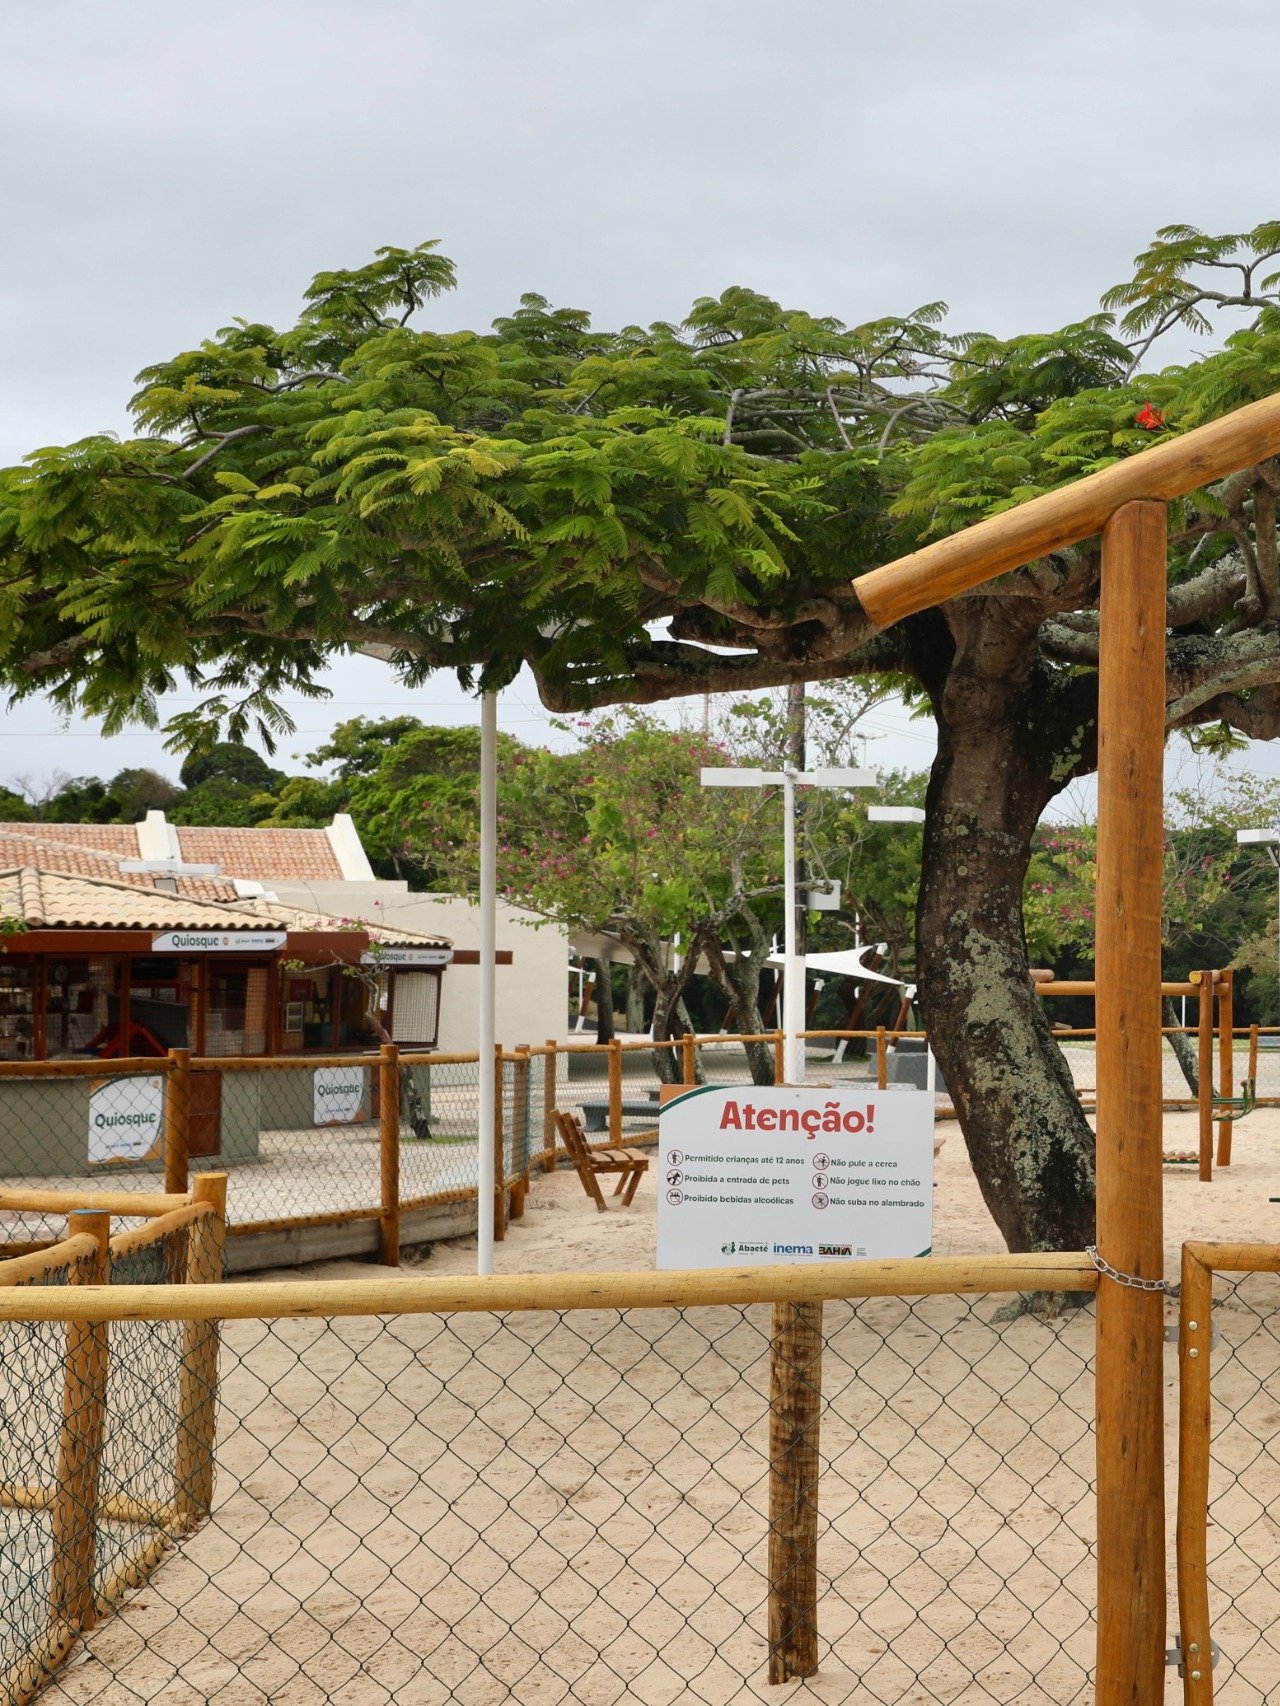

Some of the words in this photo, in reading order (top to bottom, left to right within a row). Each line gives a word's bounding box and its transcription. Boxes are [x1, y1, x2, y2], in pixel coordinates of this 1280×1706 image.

[171, 934, 219, 948] Quiosque
[317, 1083, 360, 1097] Quiosque
[95, 1112, 156, 1129] Quiosque
[719, 1100, 875, 1140] Atenção!
[684, 1154, 724, 1163] Permitido
[725, 1155, 759, 1165] crianças
[760, 1156, 774, 1164] até
[775, 1156, 784, 1164] 12
[830, 1159, 847, 1167] Não
[848, 1160, 867, 1168] pule
[684, 1174, 718, 1183] Proibida
[726, 1175, 757, 1184] entrada
[759, 1176, 770, 1185] de
[771, 1177, 790, 1186] pets
[830, 1177, 846, 1185] Não
[847, 1177, 870, 1187] jogue
[871, 1177, 887, 1185] lixo
[900, 1178, 921, 1186] chão
[684, 1194, 718, 1203] Proibido
[719, 1195, 752, 1204] bebidas
[753, 1196, 794, 1204] alcoólicas
[830, 1197, 846, 1205] Não
[847, 1198, 867, 1206] suba
[881, 1199, 925, 1207] alambrado
[773, 1242, 814, 1254] inema
[818, 1246, 852, 1256] BAHIA
